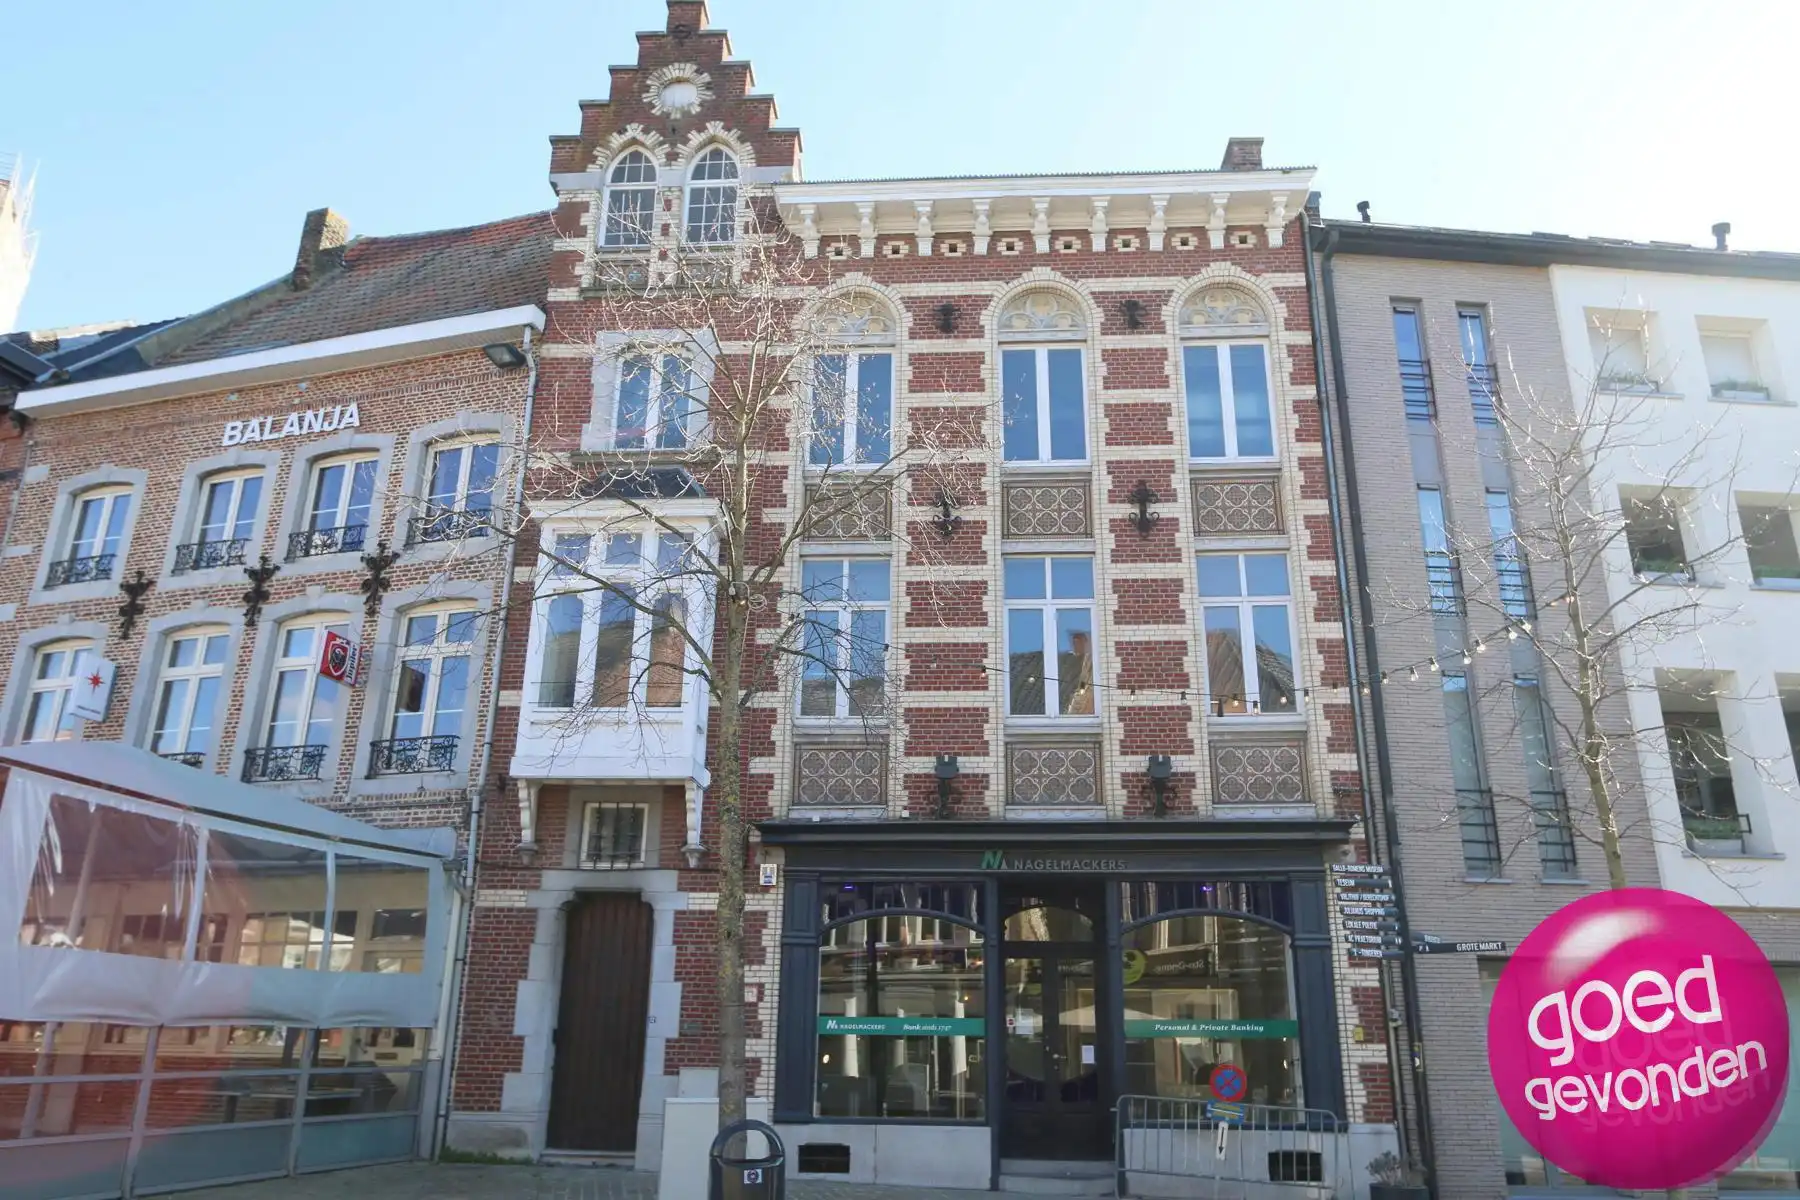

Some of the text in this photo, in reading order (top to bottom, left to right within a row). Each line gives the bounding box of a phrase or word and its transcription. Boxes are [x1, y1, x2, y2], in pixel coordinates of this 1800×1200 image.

[221, 402, 360, 446] BALANJA
[346, 644, 358, 680] Jupiler
[1013, 859, 1127, 870] NAGELMACKERS
[1364, 907, 1386, 916] SHOPPING
[1345, 920, 1361, 929] LOKALE
[1456, 943, 1478, 952] GROTE
[1479, 942, 1502, 950] MARKT
[1230, 1024, 1264, 1033] Banking
